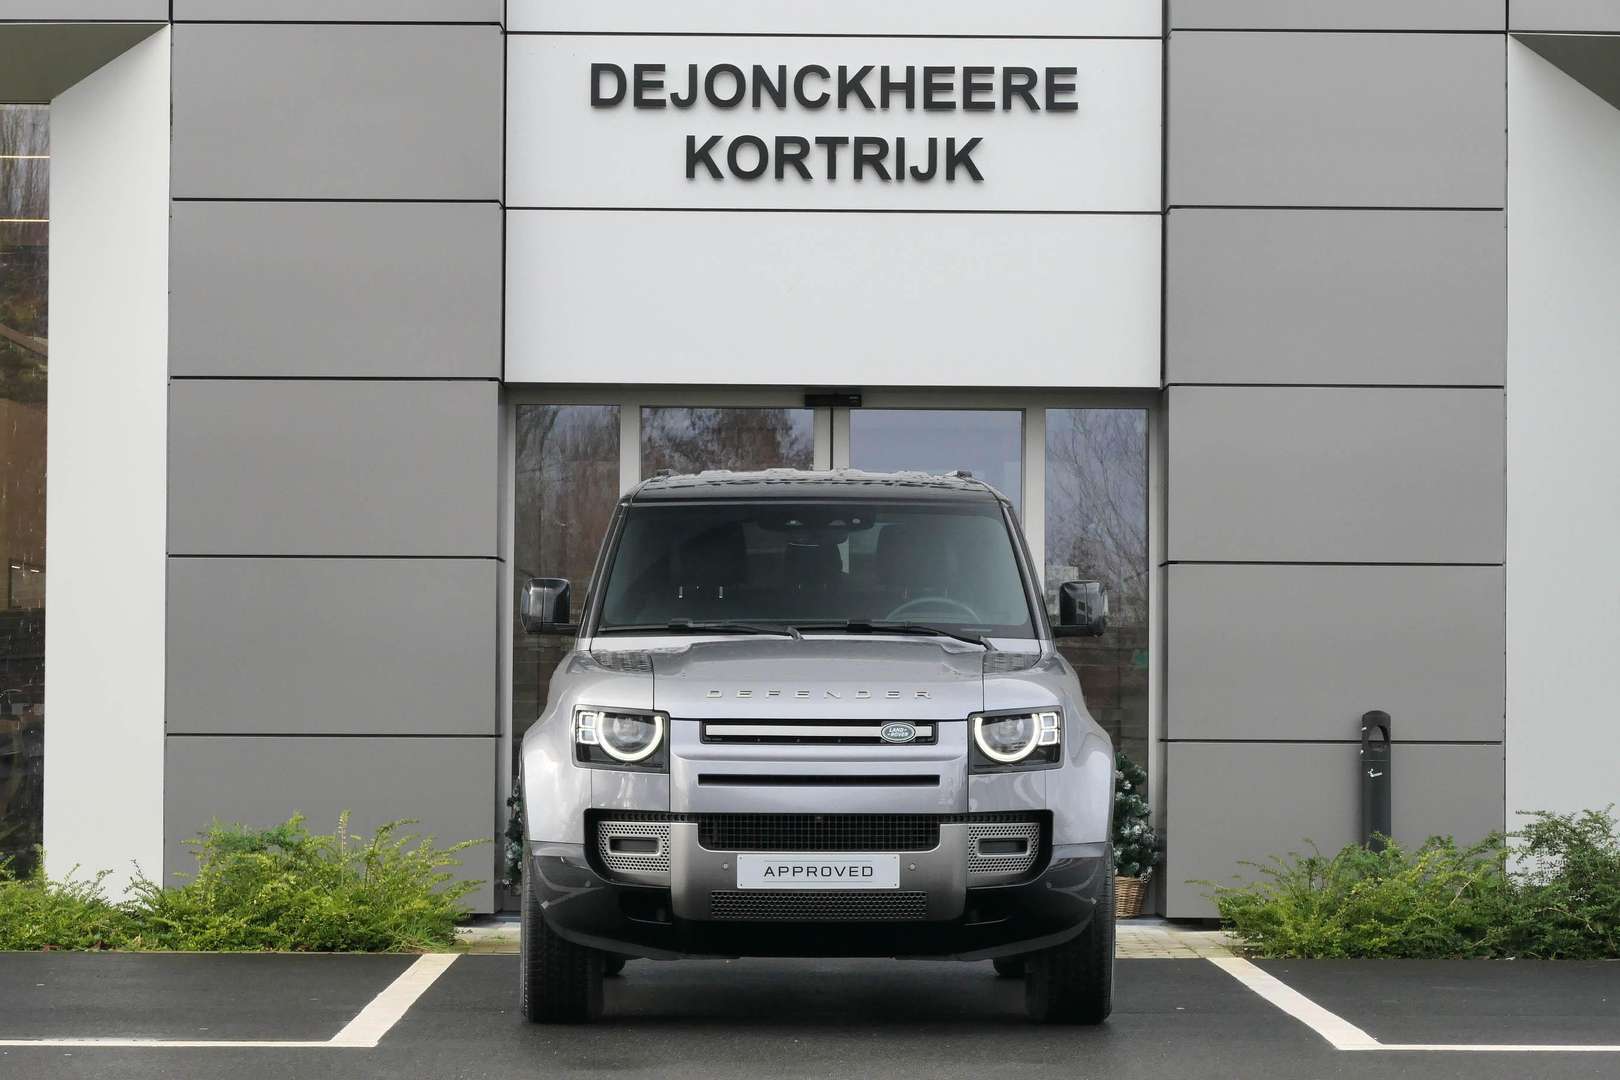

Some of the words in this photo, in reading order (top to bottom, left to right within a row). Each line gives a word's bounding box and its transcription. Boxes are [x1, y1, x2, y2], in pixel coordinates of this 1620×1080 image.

[591, 64, 1078, 112] DEJONCKHEERE
[686, 135, 984, 184] KORTRIJK
[706, 688, 932, 699] DEFENDER
[763, 866, 873, 877] APPROVED
